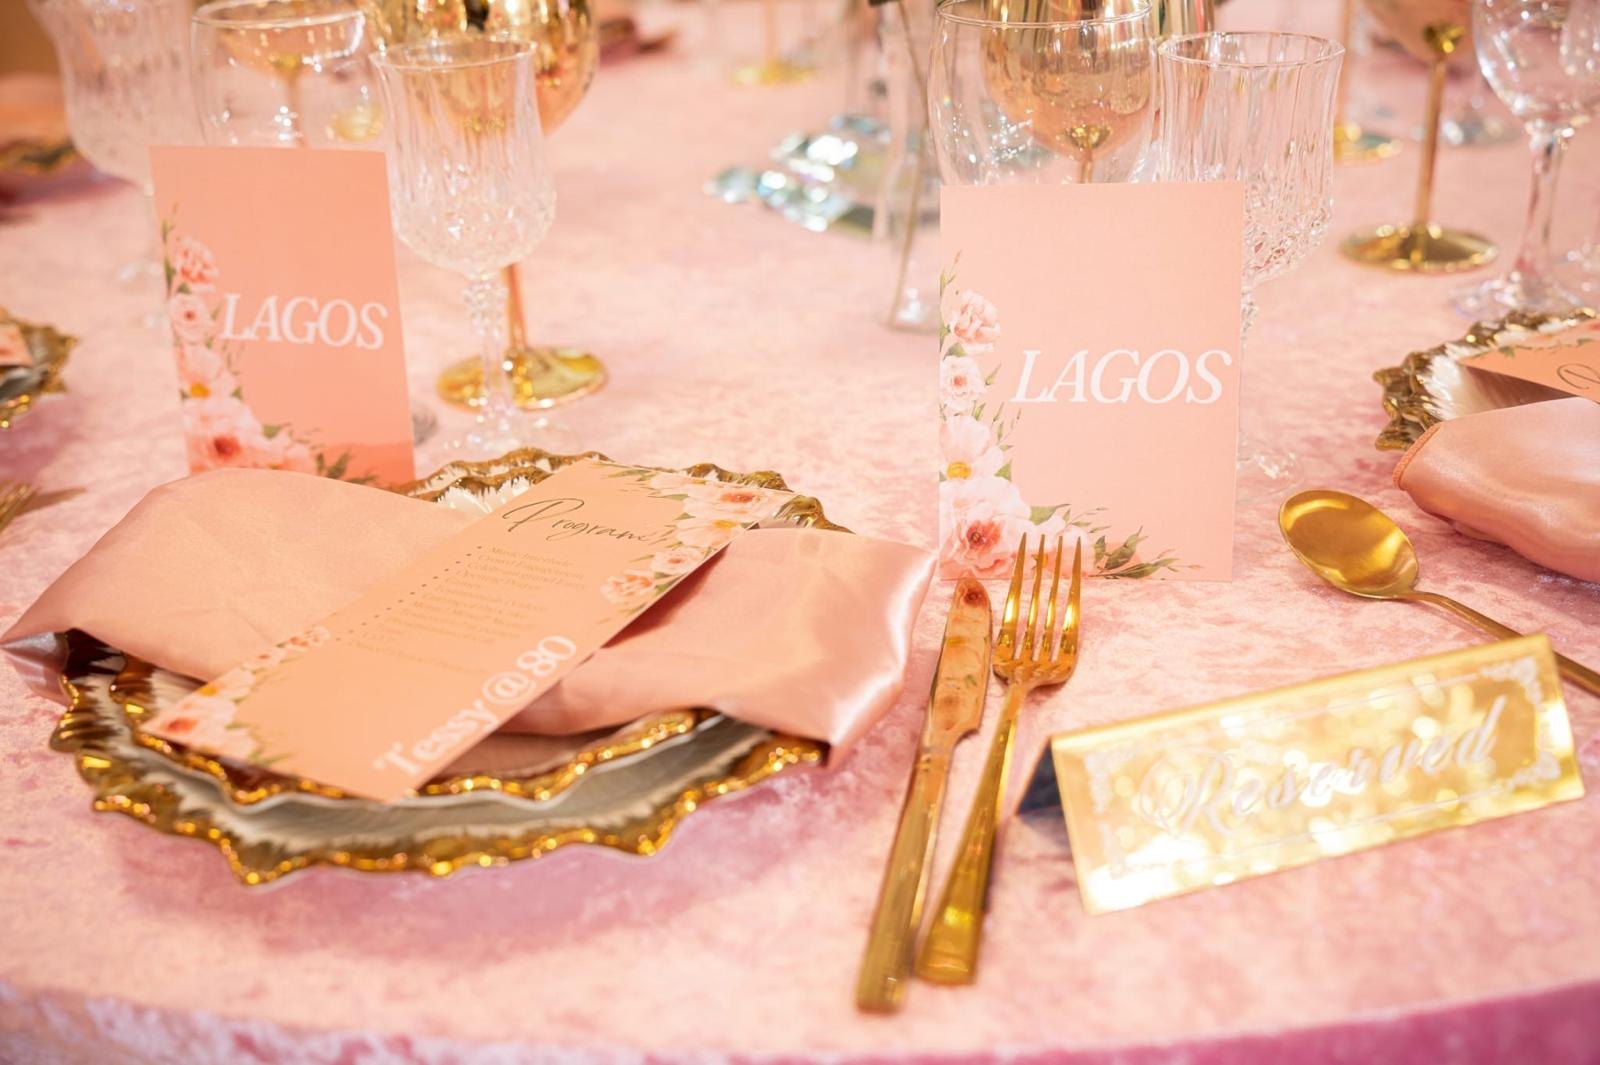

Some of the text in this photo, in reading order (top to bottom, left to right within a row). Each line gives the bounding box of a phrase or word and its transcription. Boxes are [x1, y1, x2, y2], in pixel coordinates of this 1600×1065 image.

[219, 293, 388, 350] LAGOS
[1009, 348, 1233, 404] LAGOS
[372, 634, 577, 777] Tessy@80
[1136, 695, 1507, 838] Reserved
